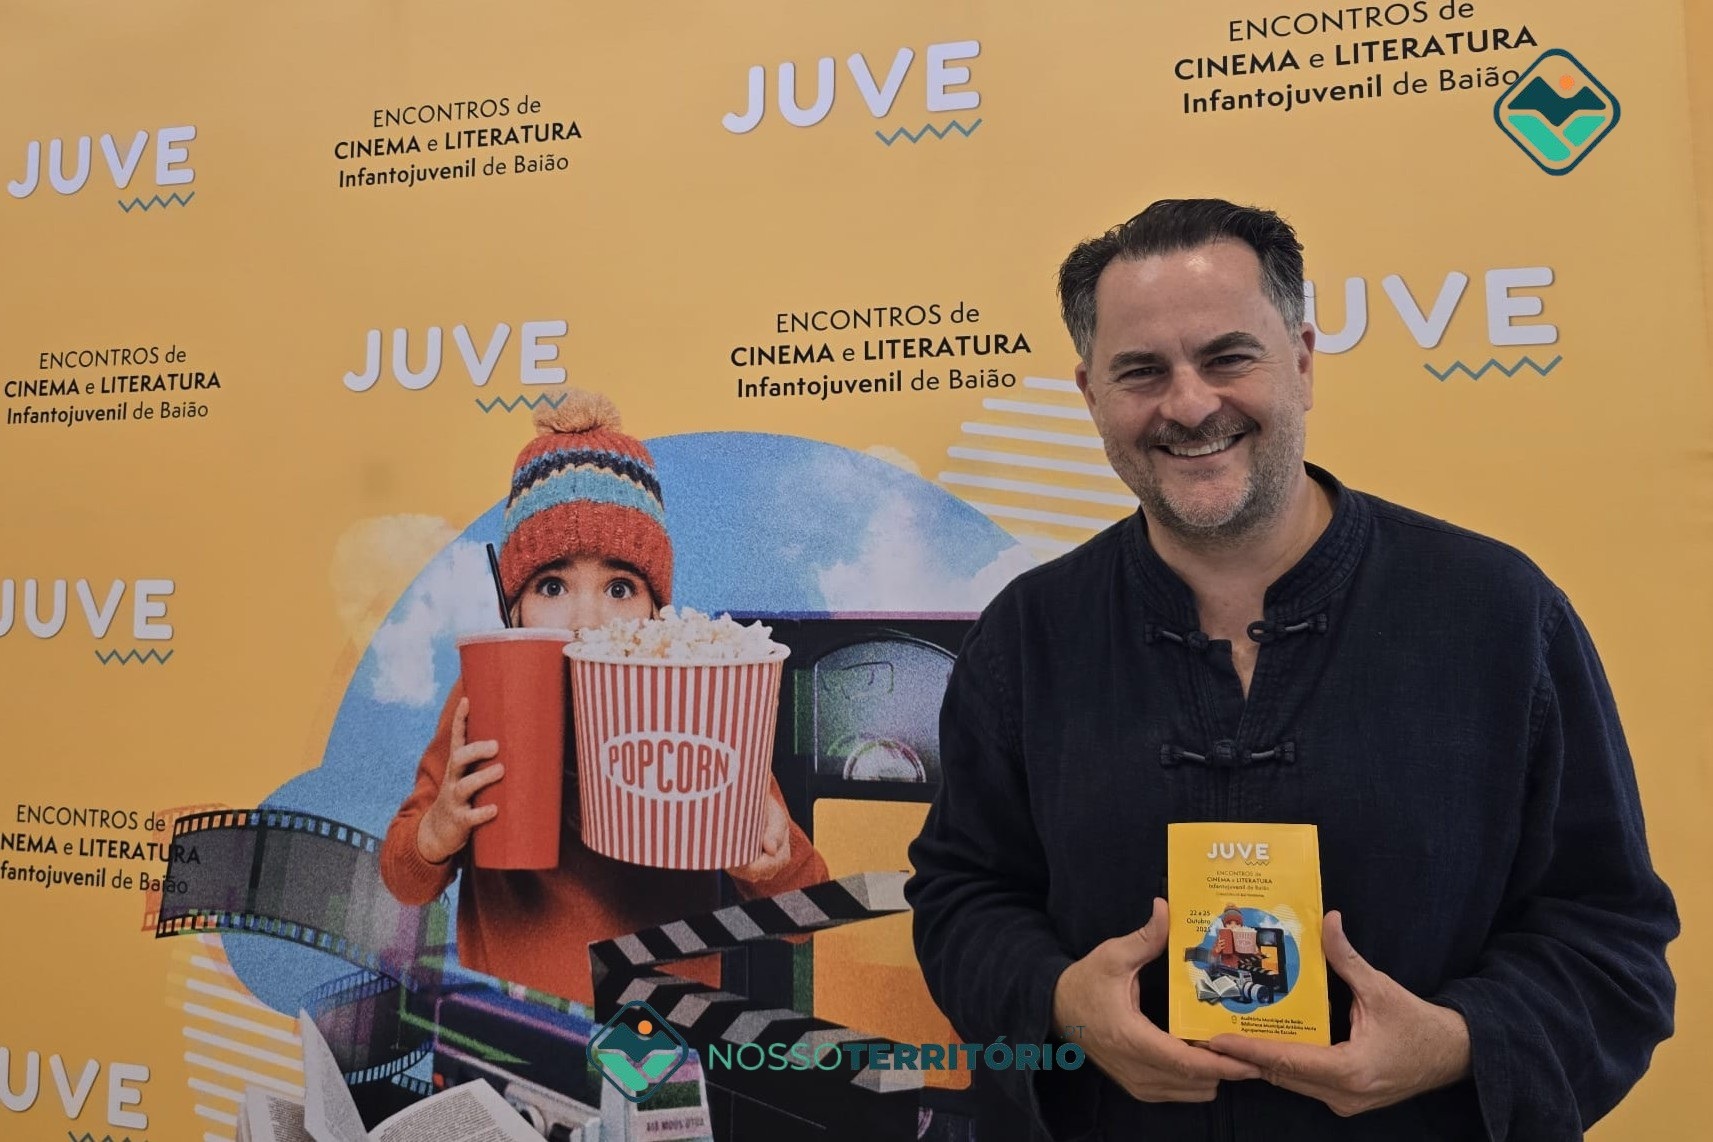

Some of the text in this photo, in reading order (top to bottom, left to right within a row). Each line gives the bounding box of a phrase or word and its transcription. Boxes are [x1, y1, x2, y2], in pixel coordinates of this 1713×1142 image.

[1228, 0, 1476, 42] ENCONTROS de
[1174, 25, 1539, 81] CINEMA e LITERATURA
[722, 40, 981, 134] JUVE
[1183, 65, 1520, 115] Infantojuvenil de Baião
[373, 94, 542, 128] ENCONTROS de
[334, 121, 582, 160] CINEMA e LITERATURA
[7, 125, 197, 198] JUVE
[338, 153, 569, 189] Infantojuvenil de Baião
[776, 301, 980, 333] ENCONTROS de
[1303, 266, 1558, 355] UVE
[39, 345, 187, 370] ENCONTROS de
[343, 320, 569, 392] JUVE
[730, 333, 1031, 367] CINEMA e LITERATURA
[4, 372, 221, 399] CINEMA e LITERATURA
[737, 367, 1017, 400] Infantojuvenil de Baião
[6, 399, 209, 427] Infantojuvenil de Baião
[0, 578, 175, 640] JUVE
[609, 738, 730, 795] POPCORN
[16, 804, 166, 832] ENCONTROS de
[0, 833, 201, 865] NEMA e LITERATURA
[1206, 842, 1270, 861] JUVE
[0, 861, 189, 895] fantojuvenil de Baião
[1236, 877, 1273, 885] LITERATURA
[1186, 917, 1211, 925] Outubro
[0, 1046, 150, 1130] UVE
